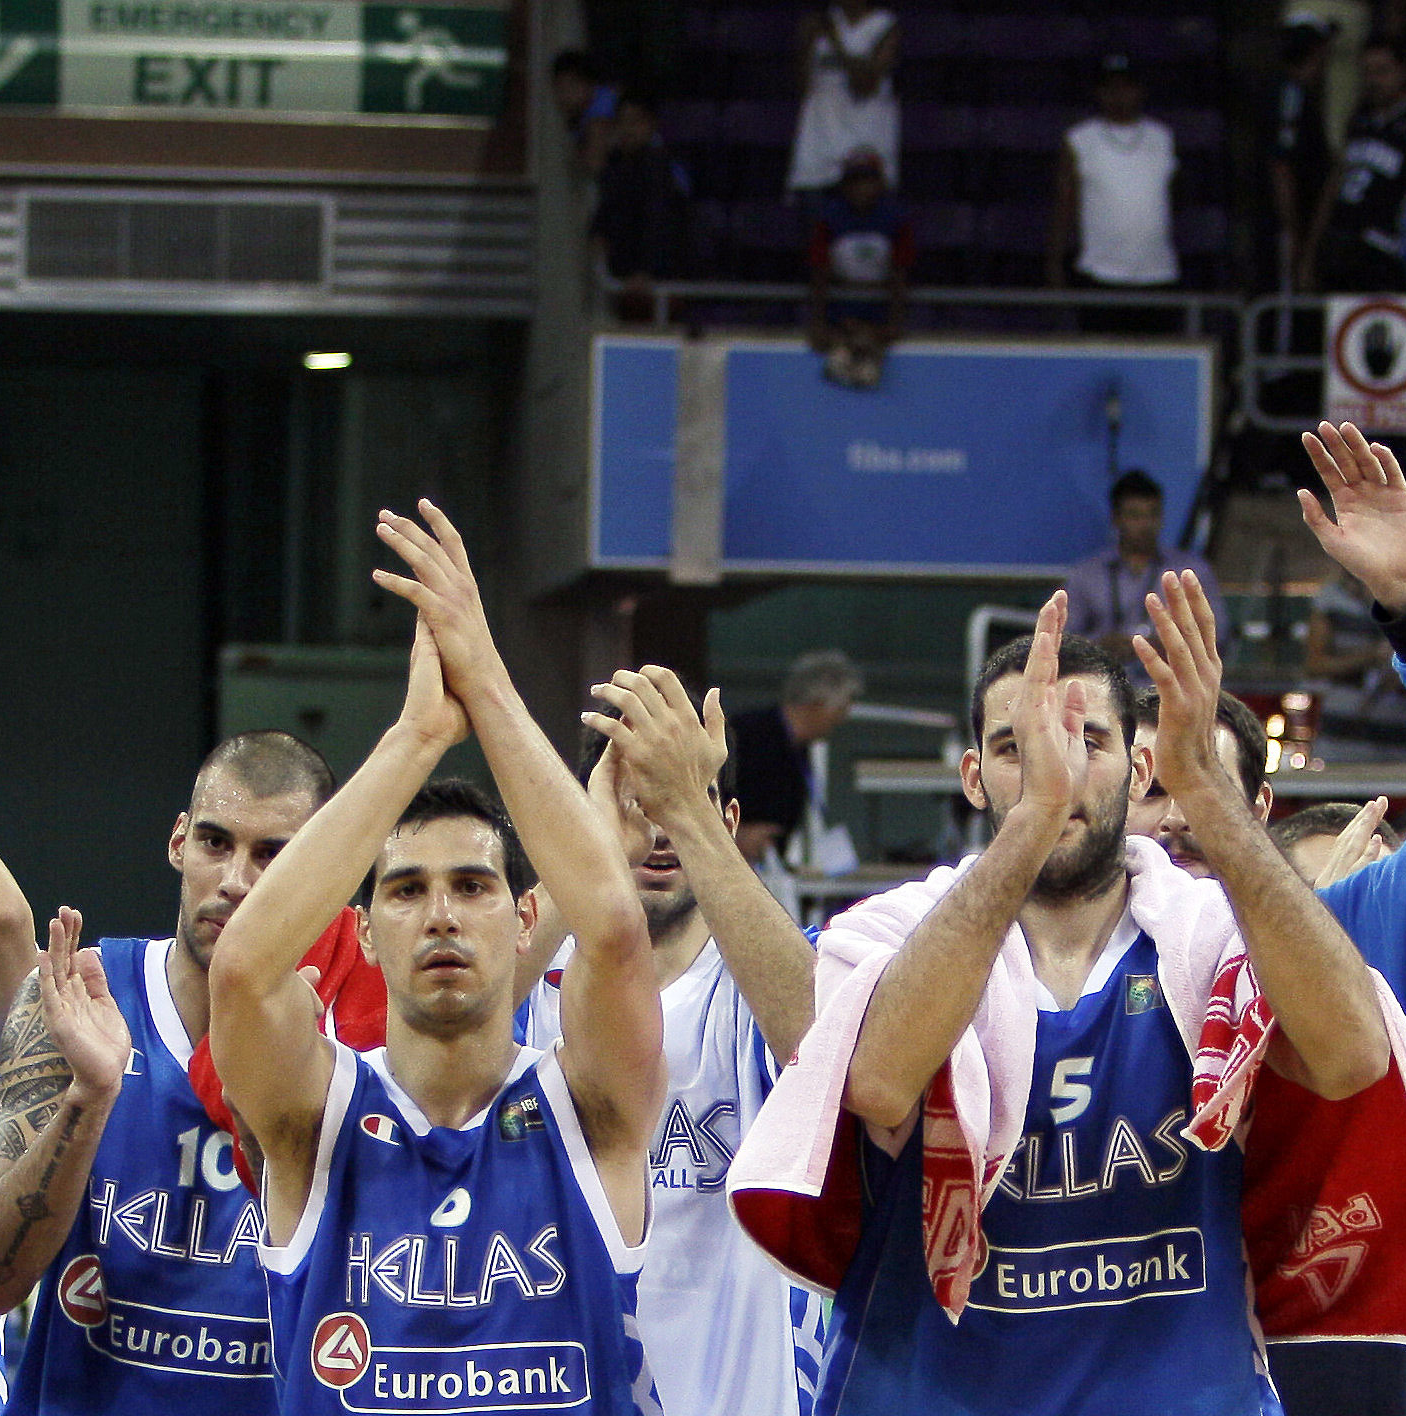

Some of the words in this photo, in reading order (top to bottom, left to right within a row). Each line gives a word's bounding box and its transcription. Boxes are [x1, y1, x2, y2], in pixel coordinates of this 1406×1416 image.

[95, 2, 335, 36] EMERGENCY
[135, 56, 286, 106] EXIT
[1049, 1055, 1095, 1125] 5
[176, 1125, 244, 1192] 10
[344, 1223, 568, 1309] HELLAS
[996, 1244, 1191, 1299] Eurobank
[373, 1356, 572, 1400] Eurobank
